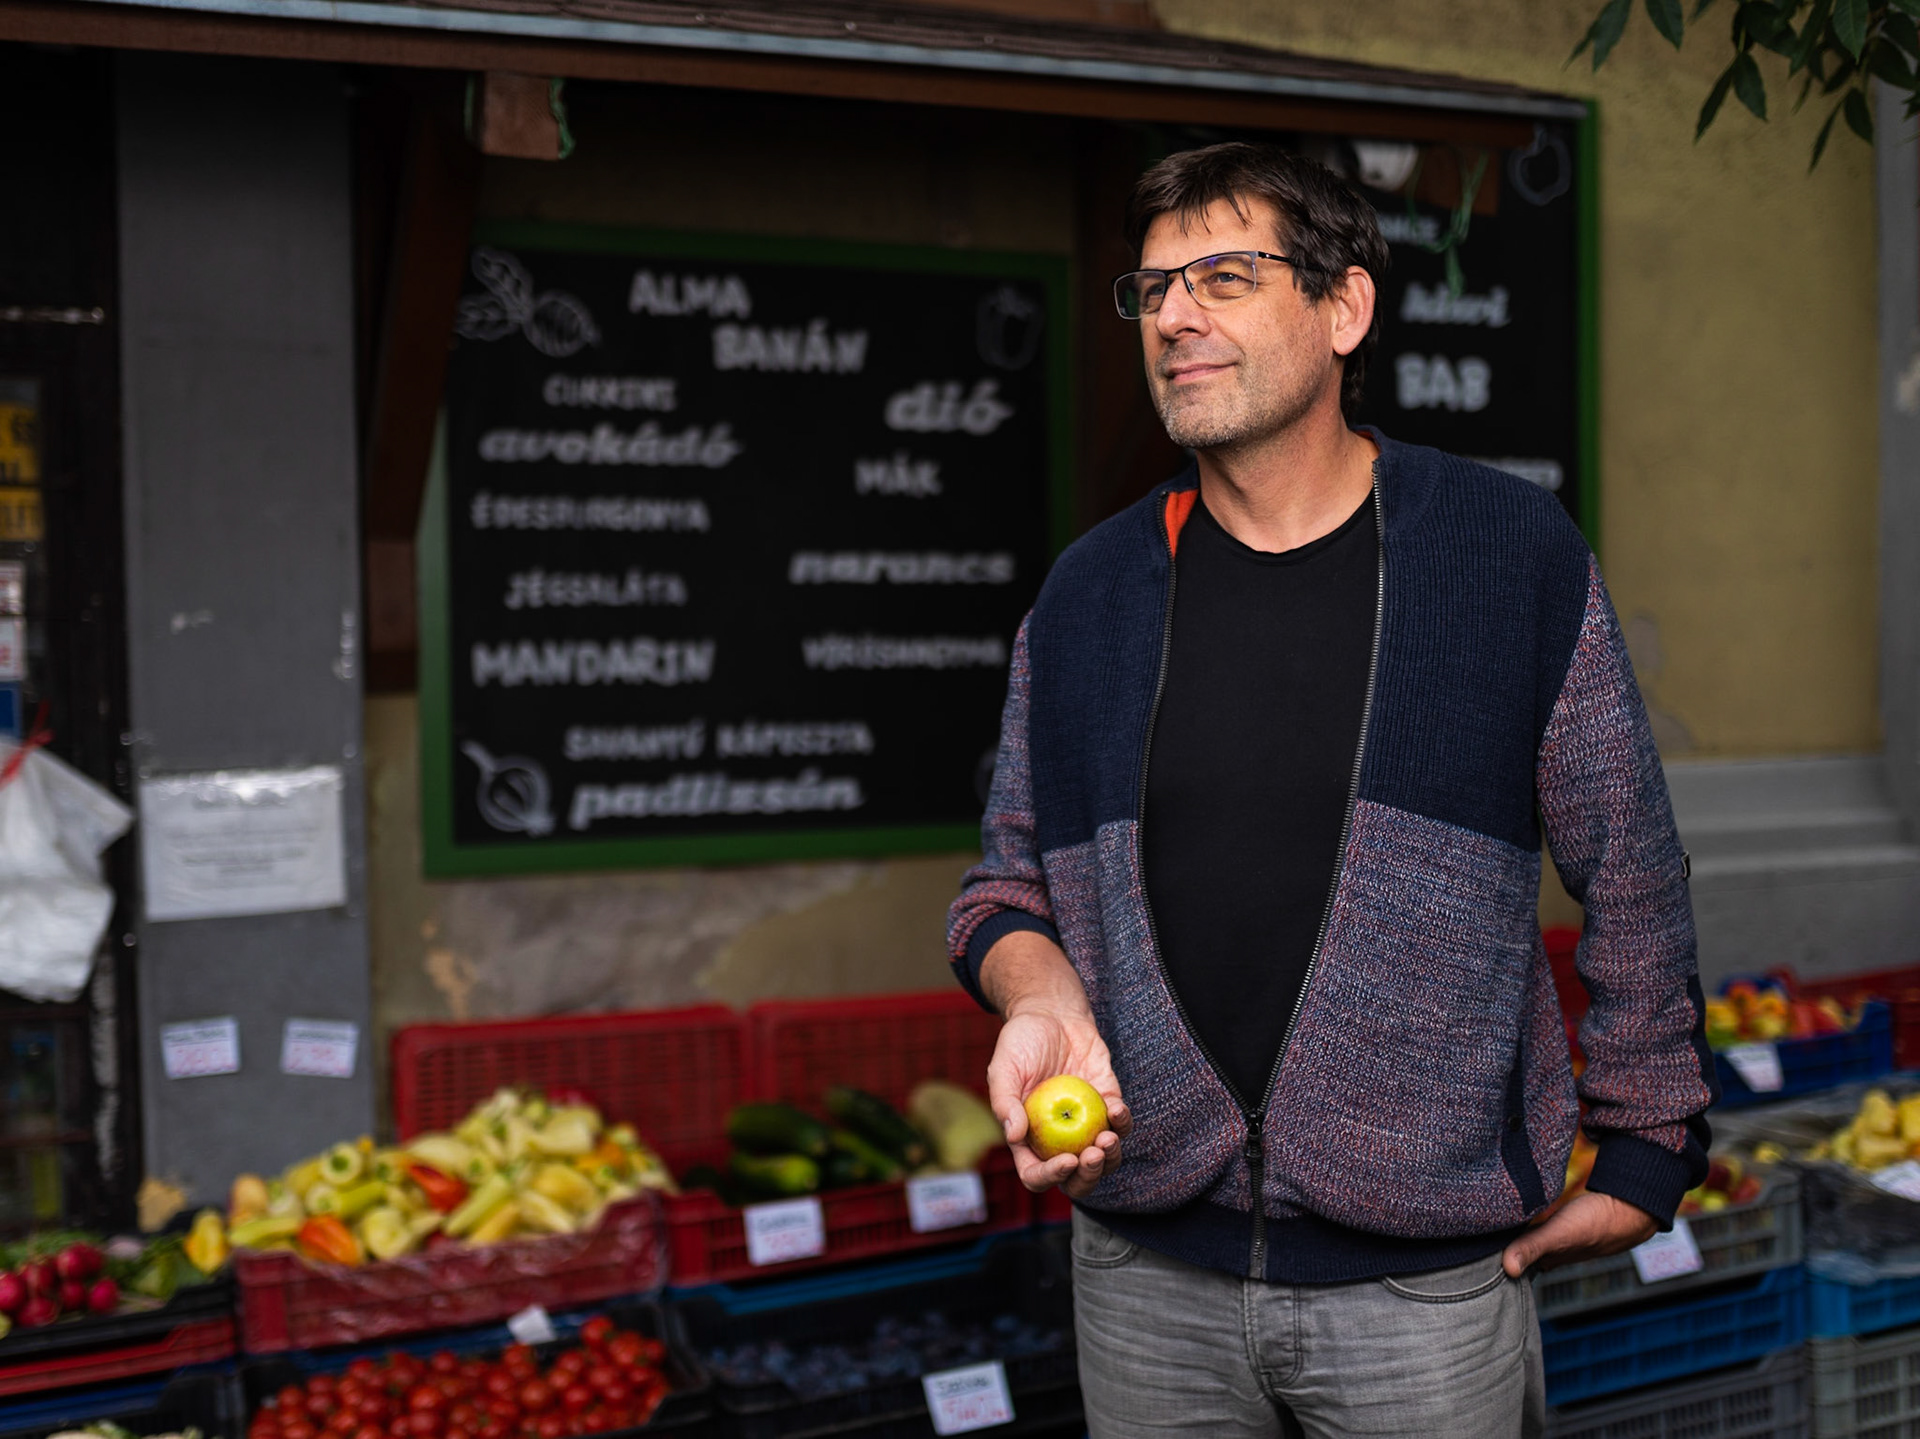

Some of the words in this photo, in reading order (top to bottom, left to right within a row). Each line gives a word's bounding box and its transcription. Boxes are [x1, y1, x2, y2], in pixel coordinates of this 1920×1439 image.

[630, 271, 751, 317] ALMA
[712, 319, 867, 372] BANÁN
[1396, 353, 1491, 412] BAB
[885, 380, 1011, 434] dió
[480, 422, 739, 467] avokádó
[856, 455, 940, 496] MÁK
[789, 552, 1012, 584] narancs
[472, 638, 714, 686] MANDARIN
